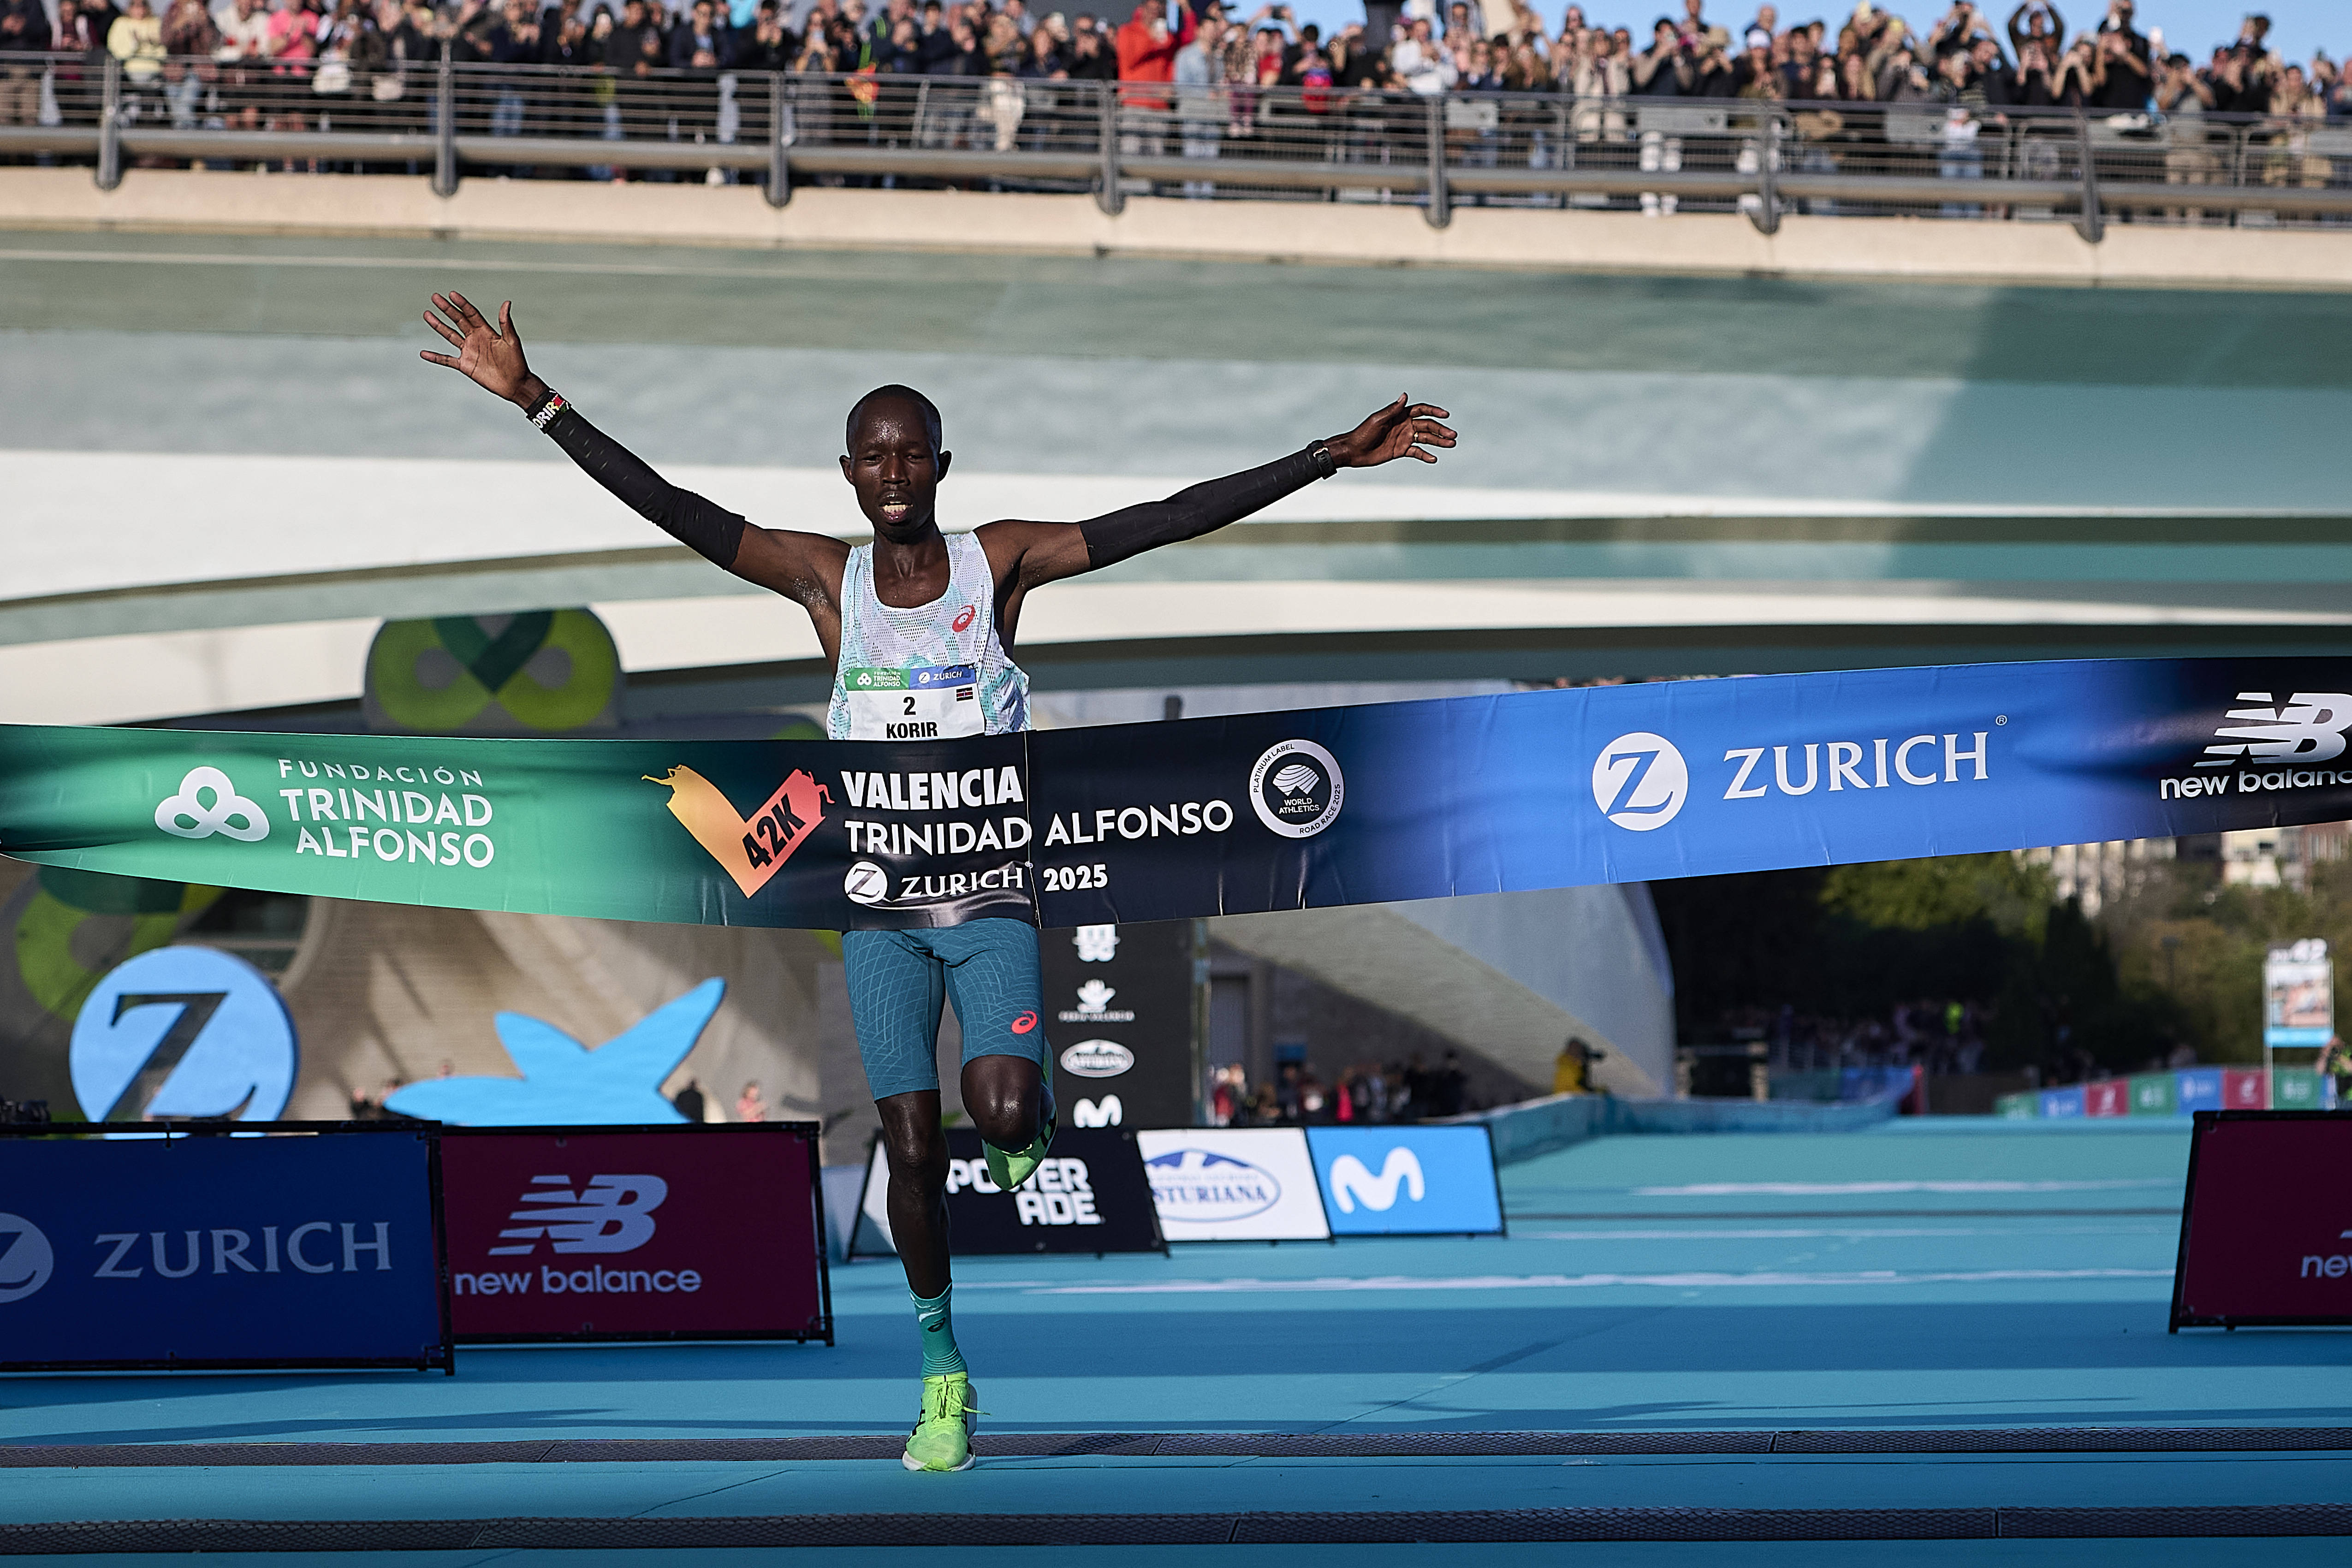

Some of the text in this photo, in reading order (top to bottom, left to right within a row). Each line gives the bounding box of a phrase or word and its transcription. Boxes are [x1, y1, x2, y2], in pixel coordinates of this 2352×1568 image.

[532, 401, 559, 428] ORIR
[933, 671, 962, 681] ZURICH
[903, 696, 916, 715] 2
[886, 722, 938, 739] KORIR
[278, 759, 483, 787] FUNDACIÓN
[1253, 743, 1295, 793] PLATINUM LABEL
[1723, 731, 1988, 800] ZURICH
[840, 766, 1023, 810] VALENCIA
[2161, 769, 2352, 800] new balanc
[279, 788, 493, 827] TRINIDAD
[1279, 804, 1320, 814] ATHLETICS
[1284, 798, 1313, 806] WORLD
[742, 796, 806, 870] 42K
[844, 800, 1234, 856] TRINIDAD ALFONSO
[1299, 822, 1321, 834] ROAD
[1321, 806, 1336, 825] RACE
[296, 826, 495, 868] ALFONSO
[901, 867, 1023, 897] ZURICH
[1043, 864, 1108, 892] 2025
[1015, 1191, 1102, 1225] ADE
[1152, 1185, 1267, 1203] STURIANA
[93, 1222, 392, 1278] ZURICH
[454, 1264, 702, 1295] new balance
[2300, 1254, 2352, 1278] ne
